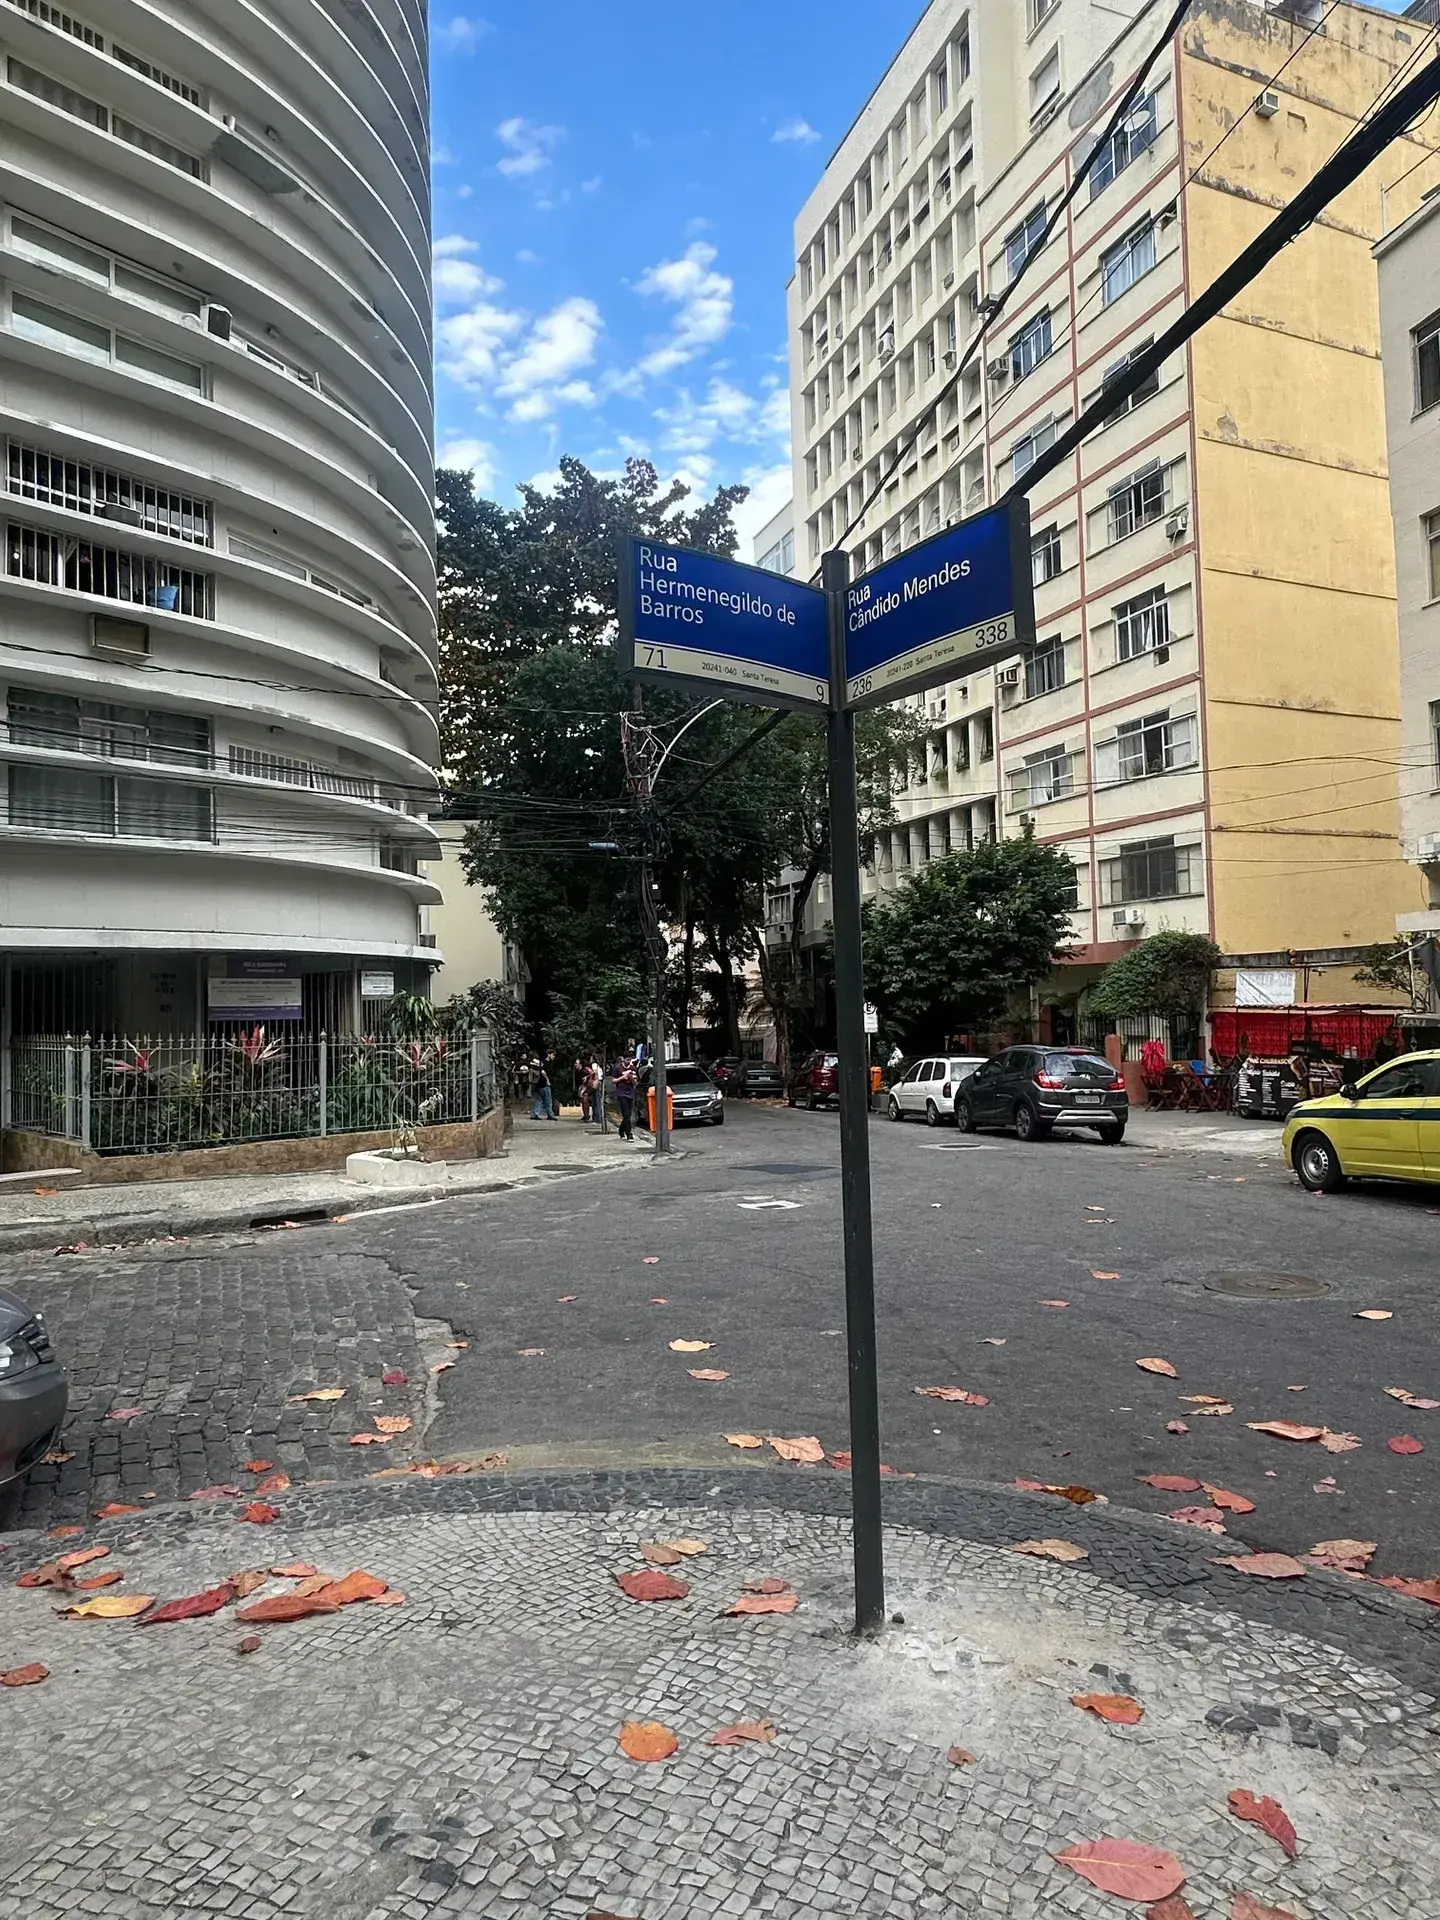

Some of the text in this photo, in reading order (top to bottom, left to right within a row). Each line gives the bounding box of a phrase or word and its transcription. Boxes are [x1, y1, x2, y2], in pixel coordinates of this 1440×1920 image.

[640, 546, 677, 572] Rua
[640, 570, 796, 625] Hermenegildo de
[848, 585, 871, 610] Rua
[849, 559, 971, 632] Cândido Mendes
[640, 595, 704, 624] Barros
[975, 621, 1008, 649] 338
[643, 646, 667, 669] 71
[916, 652, 933, 666] Santa
[934, 645, 955, 658] Teresa
[702, 661, 780, 685] 20241-040 Santa Teresa
[816, 684, 824, 702] 9
[852, 675, 873, 698] 236
[1401, 1018, 1426, 1027] TAXI
